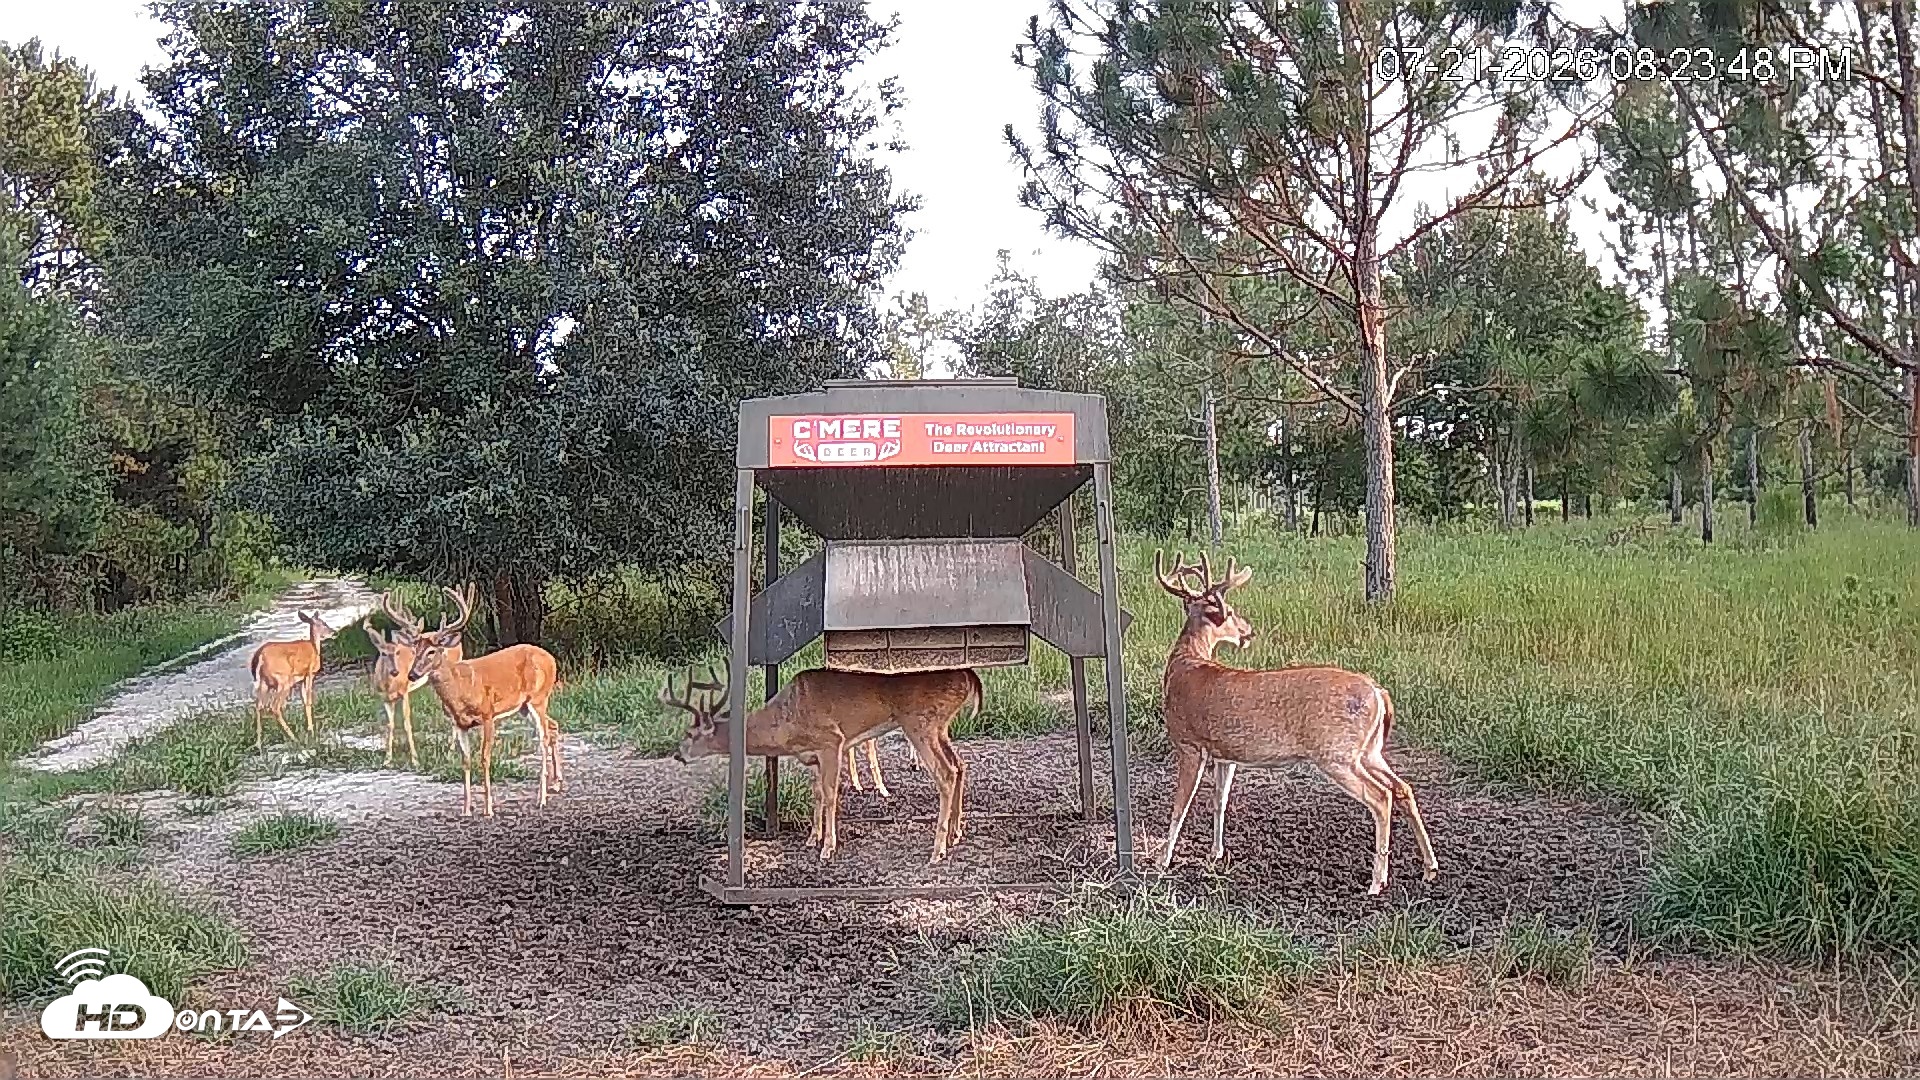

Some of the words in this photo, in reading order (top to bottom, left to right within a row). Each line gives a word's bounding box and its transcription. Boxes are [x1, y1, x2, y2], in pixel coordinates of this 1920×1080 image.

[793, 419, 901, 439] C'MERE
[925, 423, 951, 437] The
[956, 422, 1056, 438] Revolutionary
[823, 447, 871, 457] DEER
[933, 440, 968, 453] Deer
[971, 440, 1045, 453] Attractant
